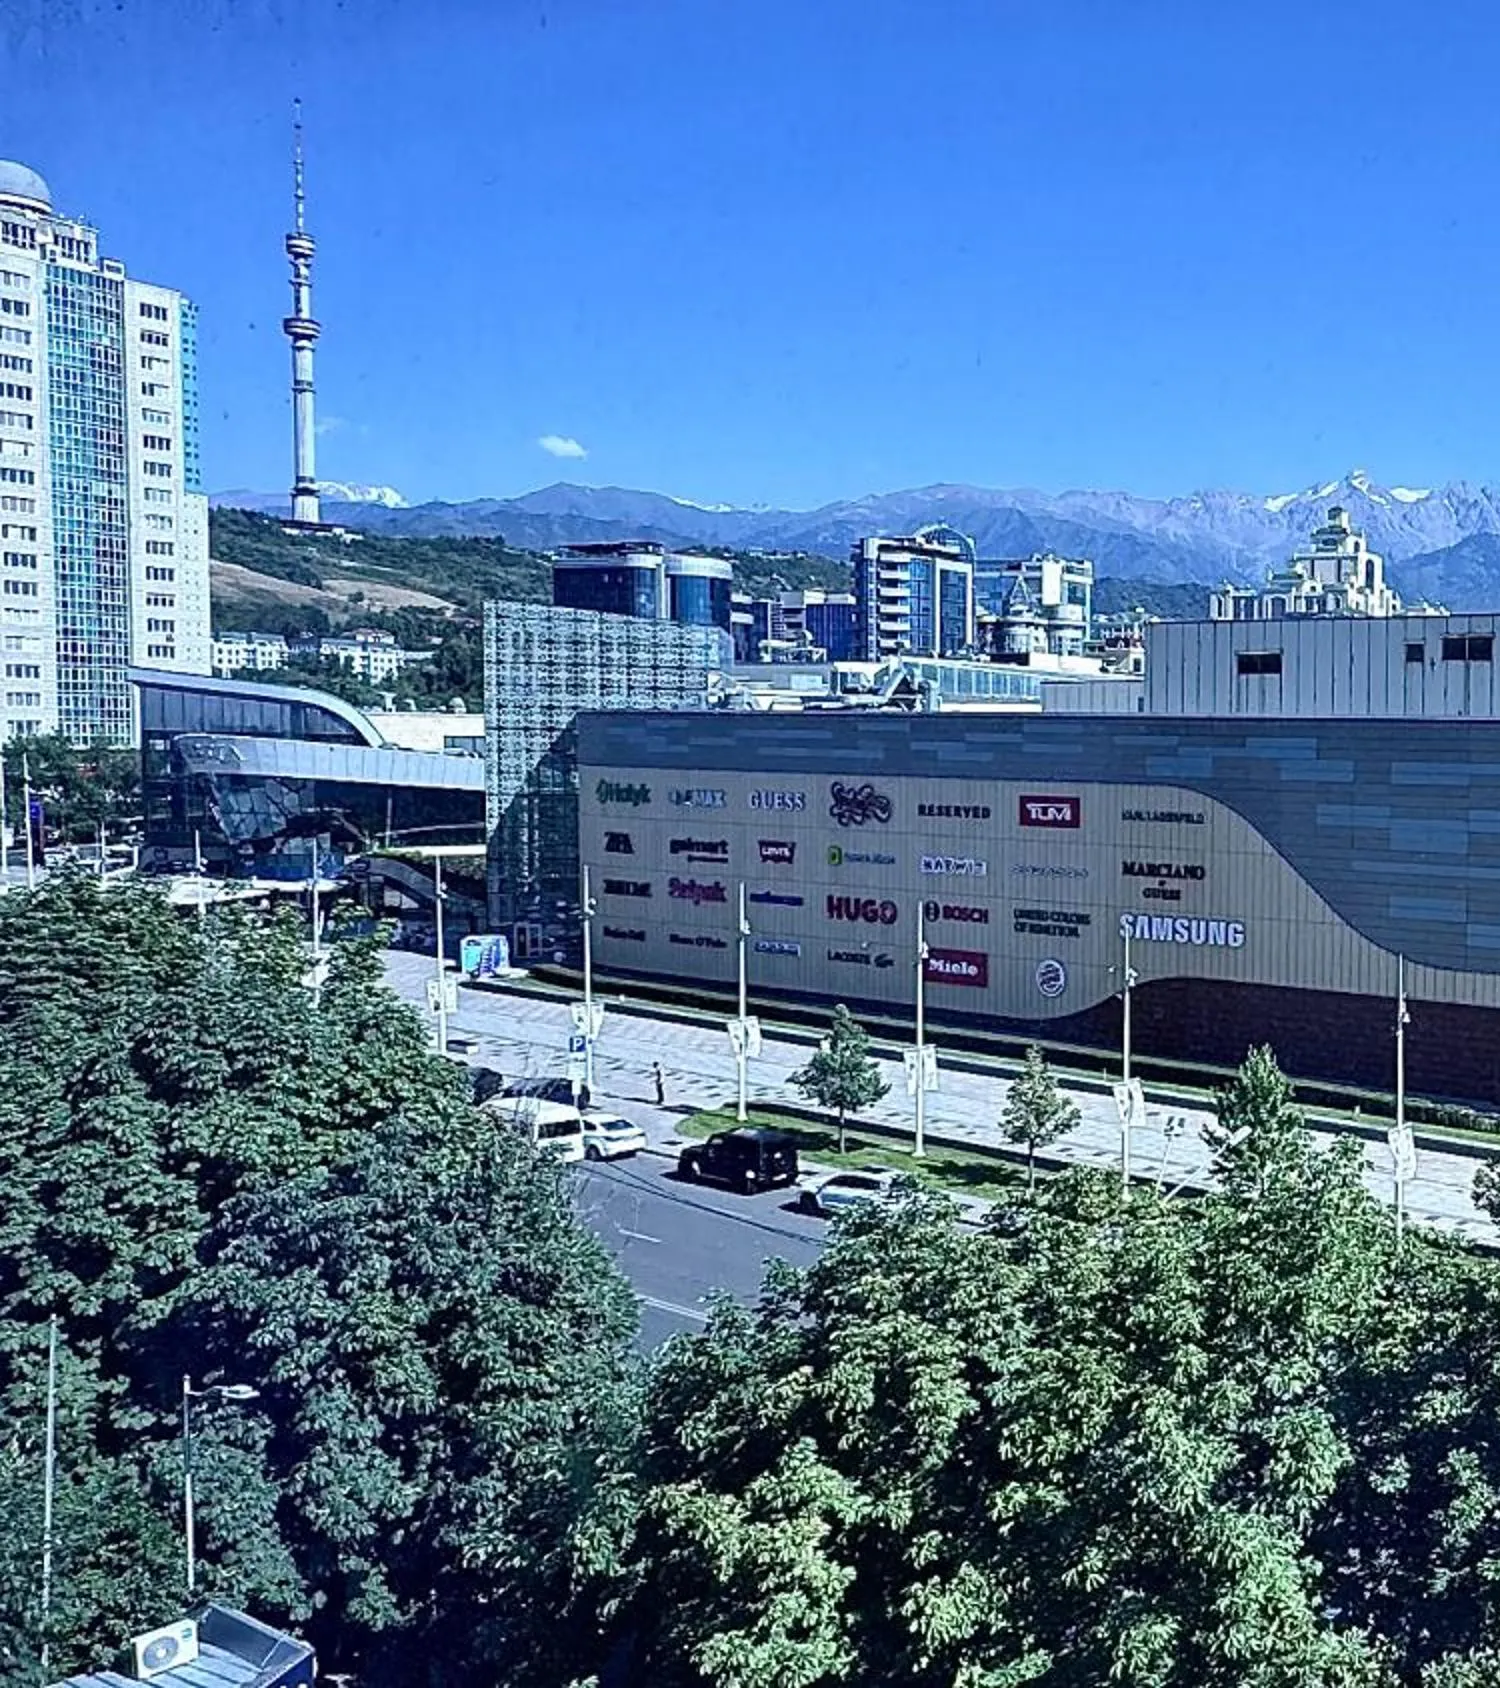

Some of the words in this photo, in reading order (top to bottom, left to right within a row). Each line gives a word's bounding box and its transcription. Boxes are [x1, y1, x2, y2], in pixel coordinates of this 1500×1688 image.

[748, 789, 806, 812] GUESS
[918, 804, 991, 819] RESERVED
[1026, 803, 1072, 822] TUMI
[1122, 861, 1206, 881] MARCIANO
[826, 894, 898, 925] HUGO
[942, 904, 989, 924] BOSCH
[1119, 912, 1246, 947] SAMSUNG
[928, 958, 979, 977] Miele
